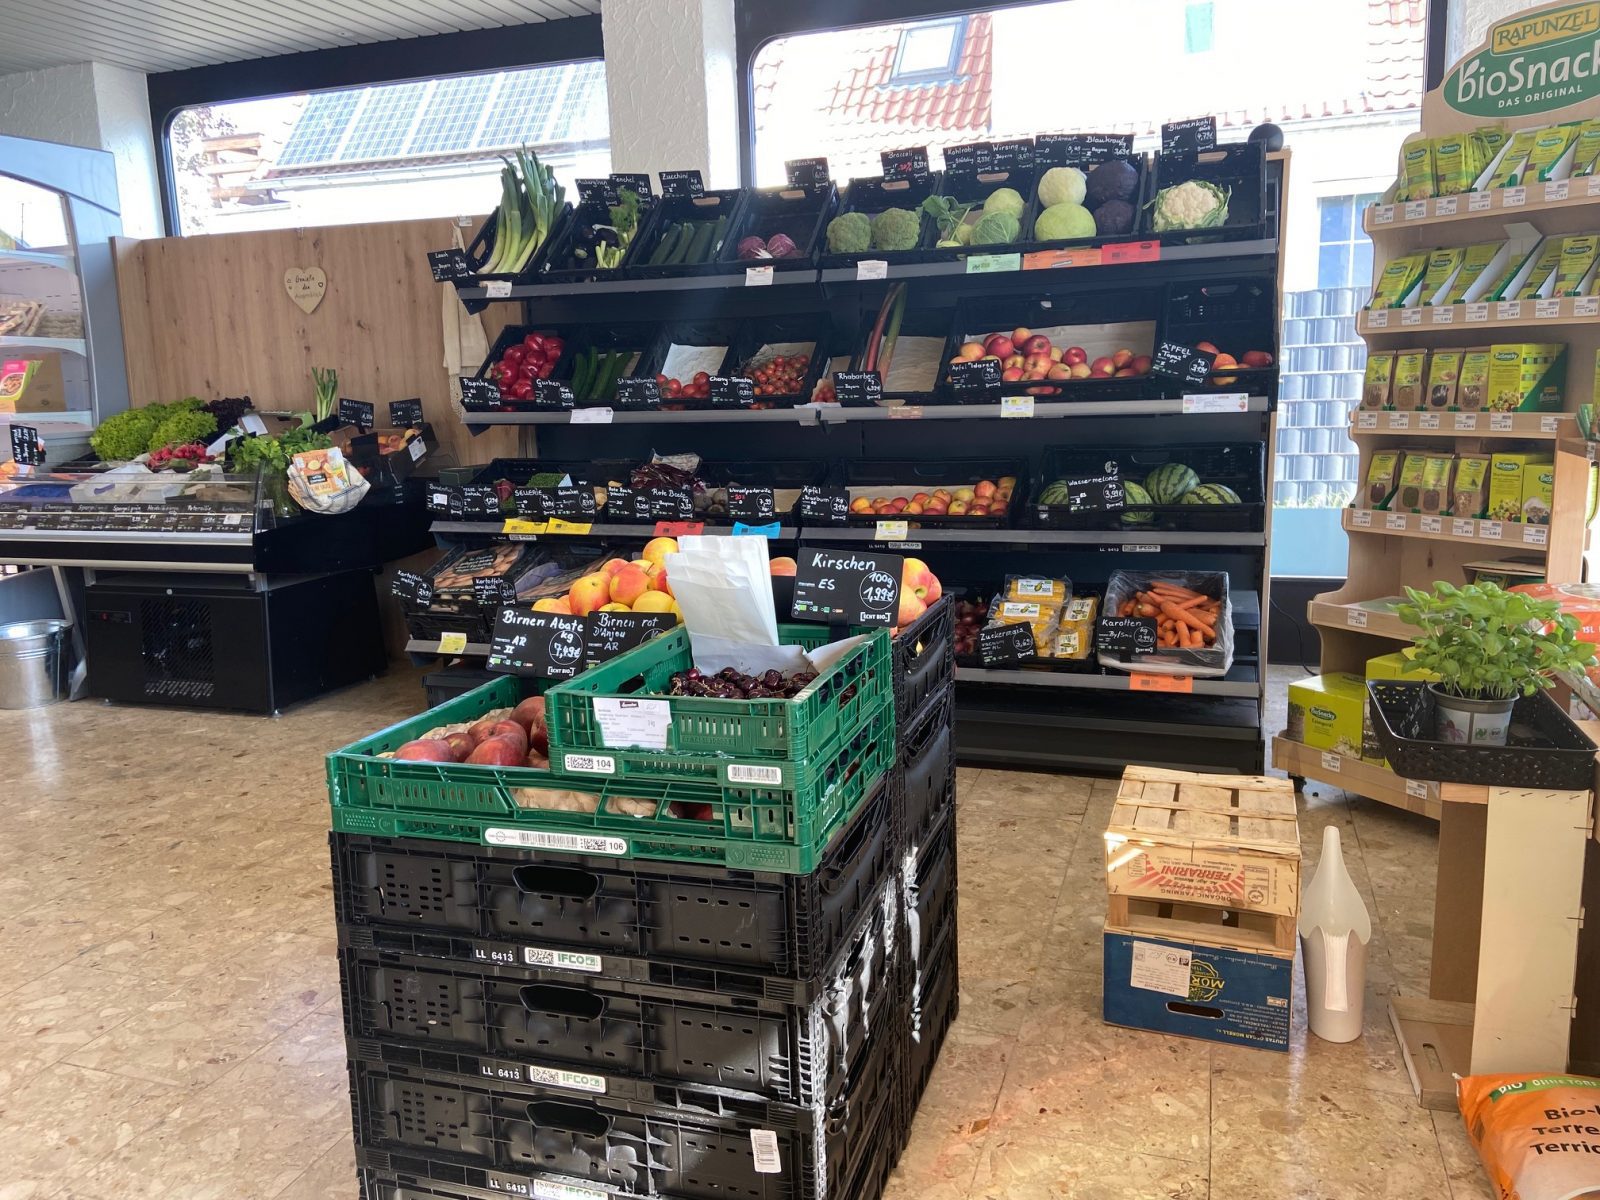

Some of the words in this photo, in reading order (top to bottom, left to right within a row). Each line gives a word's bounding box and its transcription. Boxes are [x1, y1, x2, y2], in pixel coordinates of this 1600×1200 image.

[1497, 8, 1597, 47] RAPUNZEL
[1498, 97, 1520, 109] DAS
[1524, 85, 1583, 104] ORIGINAL
[652, 488, 667, 496] Rote
[812, 552, 876, 571] Kirschen
[818, 579, 835, 590] ES
[868, 572, 893, 588] 100g
[503, 610, 546, 627] Birnen
[550, 616, 584, 632] Abate
[600, 613, 635, 627] Birnen
[642, 617, 658, 627] rot
[1102, 619, 1141, 627] Karotten
[561, 631, 573, 643] kg
[980, 626, 1024, 640] Zuckermais
[512, 636, 527, 646] AR
[604, 642, 619, 650] AR
[596, 759, 612, 769] 104
[609, 842, 624, 851] 106
[1161, 865, 1232, 882] FERRARINI
[1161, 888, 1194, 897] FARMING
[1197, 893, 1232, 903] ORGANIC
[476, 950, 487, 959] LL
[491, 951, 514, 962] 6413
[557, 953, 585, 965] IFCO
[482, 1066, 493, 1076] LL
[498, 1068, 520, 1080] 6413
[562, 1073, 589, 1085] IFCO
[490, 1178, 501, 1189] LL
[506, 1183, 527, 1194] 6413
[564, 1185, 592, 1197] IFCO
